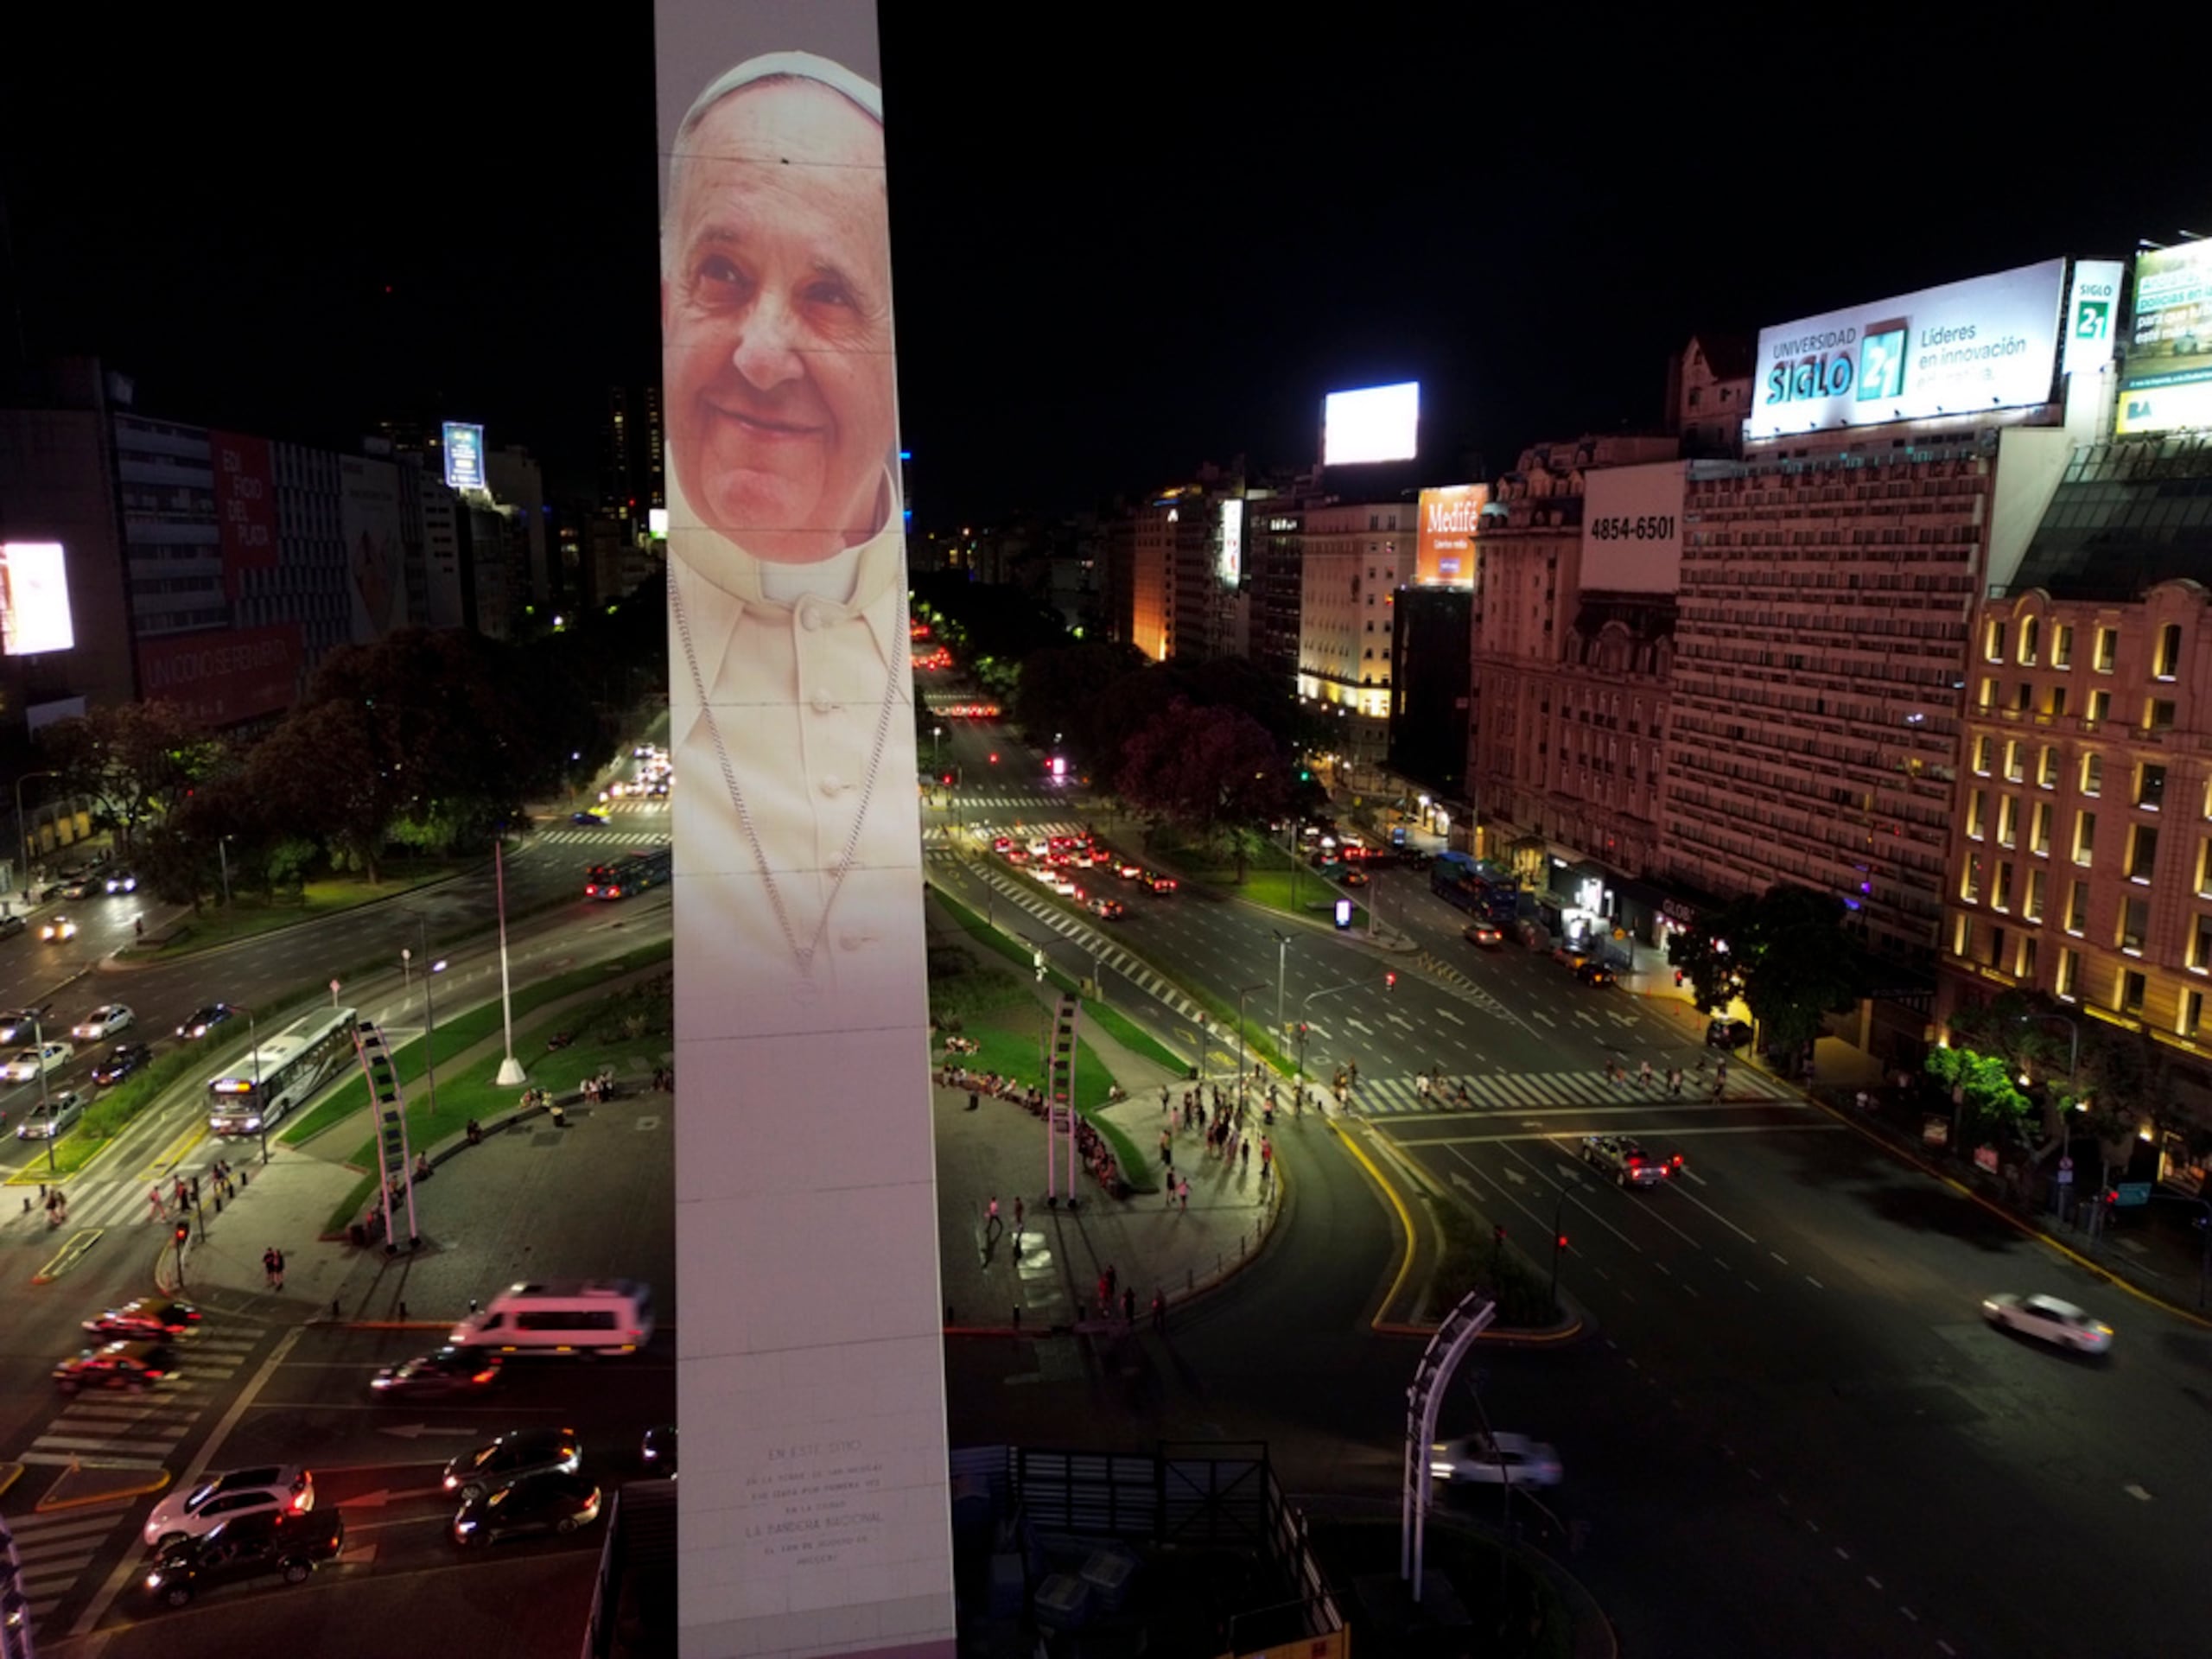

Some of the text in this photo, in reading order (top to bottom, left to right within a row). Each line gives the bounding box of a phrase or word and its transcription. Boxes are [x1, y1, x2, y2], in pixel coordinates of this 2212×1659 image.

[2079, 283, 2113, 297] SIGLO
[1920, 324, 1977, 348] Líderes
[2078, 308, 2106, 340] 21
[1773, 327, 1857, 359] UNIVERSIDAD
[1919, 334, 2027, 370] en innovación
[1766, 353, 1853, 404] SIGLO
[1862, 345, 1898, 400] 21
[226, 499, 249, 522] DEL
[1427, 500, 1478, 532] Medifé
[1592, 516, 1675, 540] 4854-6501
